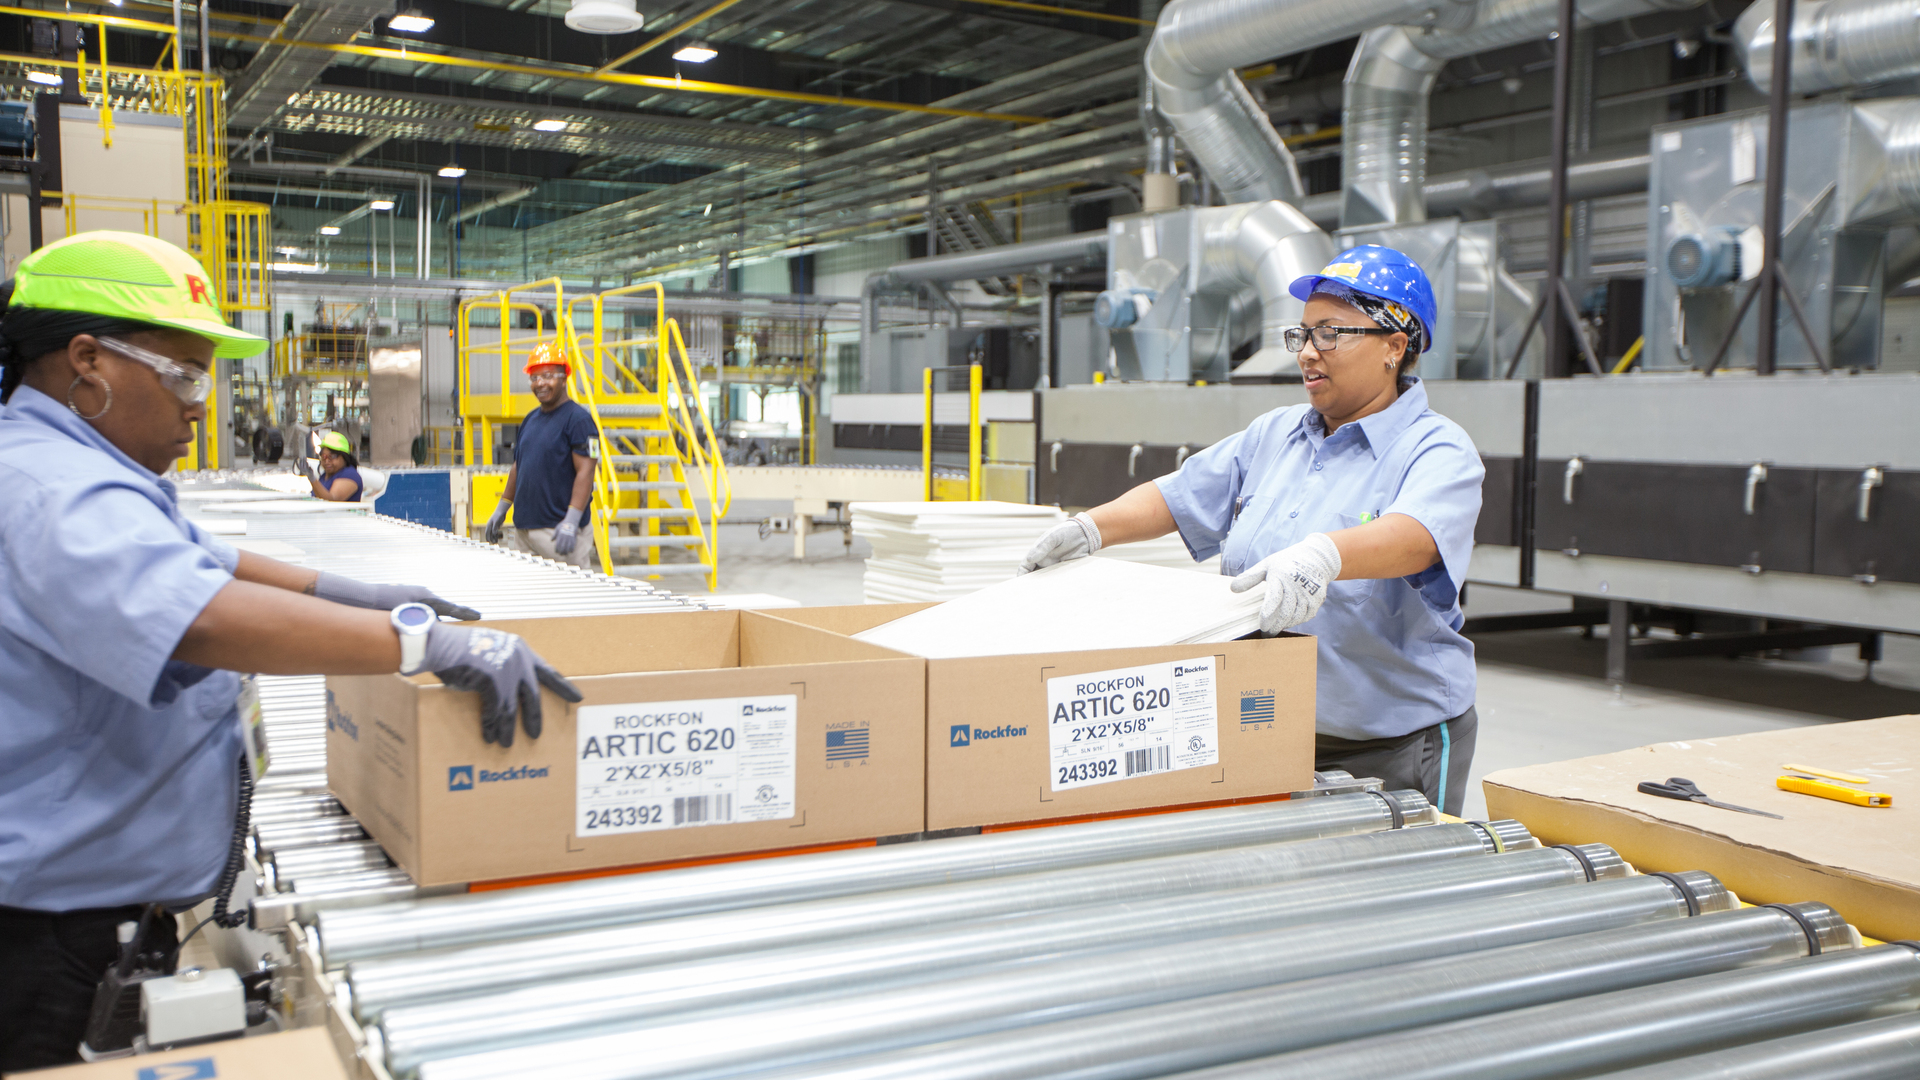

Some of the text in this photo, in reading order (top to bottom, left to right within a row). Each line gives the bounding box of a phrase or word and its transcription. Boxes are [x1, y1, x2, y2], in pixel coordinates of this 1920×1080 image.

[186, 274, 213, 307] R
[1184, 665, 1208, 674] Rockfon
[1076, 675, 1145, 696] ROCKFON
[1241, 689, 1264, 697] MADE
[1053, 694, 1125, 724] ARTIC
[1133, 687, 1171, 712] 620
[614, 711, 703, 730] ROCKFON
[826, 721, 856, 730] MADE
[1072, 717, 1154, 742] 2'X2'X5/8"
[974, 725, 1028, 740] Rockfon
[582, 730, 676, 760] ARTIC
[687, 727, 736, 752] 620
[479, 764, 550, 783] Rockfon
[1059, 758, 1117, 784] 243392
[586, 804, 662, 829] 243392
